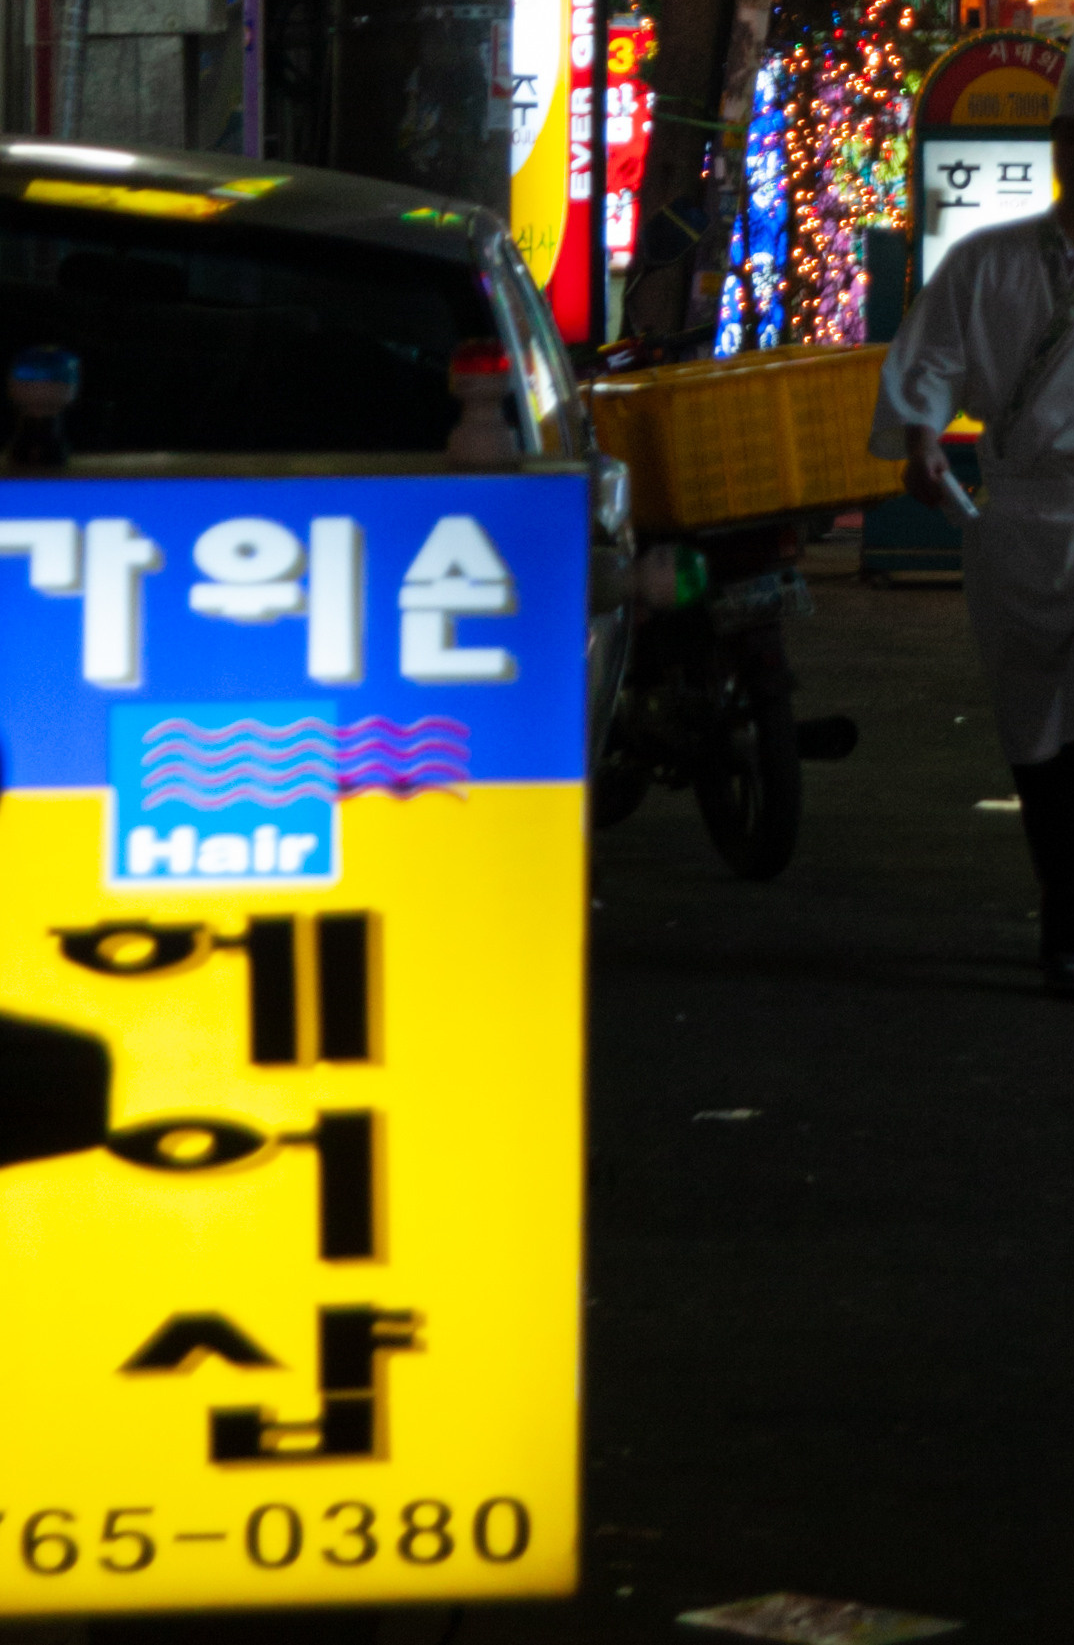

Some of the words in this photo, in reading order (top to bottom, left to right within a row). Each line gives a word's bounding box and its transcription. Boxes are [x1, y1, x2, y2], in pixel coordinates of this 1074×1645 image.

[570, 87, 592, 200] EVER
[937, 159, 1033, 208] 호프
[126, 824, 319, 877] Hair
[0, 1496, 533, 1576] 65-0380
